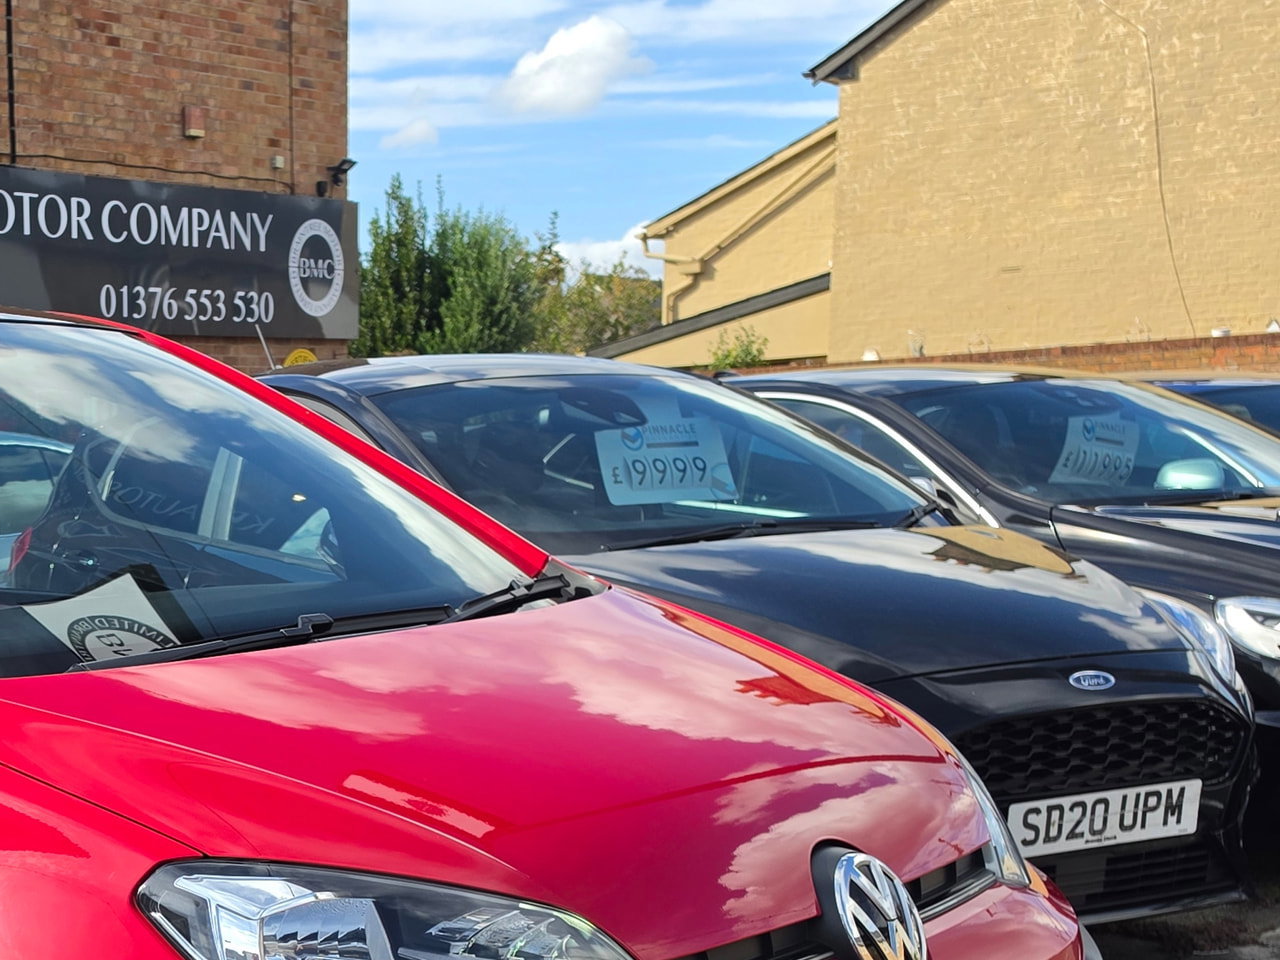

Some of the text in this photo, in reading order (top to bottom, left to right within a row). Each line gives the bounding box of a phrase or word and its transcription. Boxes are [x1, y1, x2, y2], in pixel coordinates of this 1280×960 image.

[101, 200, 273, 252] COMPANY
[299, 257, 336, 280] BMC
[100, 284, 178, 320] 01376
[184, 288, 226, 322] 553
[231, 291, 274, 323] 530
[641, 423, 698, 437] PINNACLE
[1020, 785, 1186, 847] SD20 UPM
